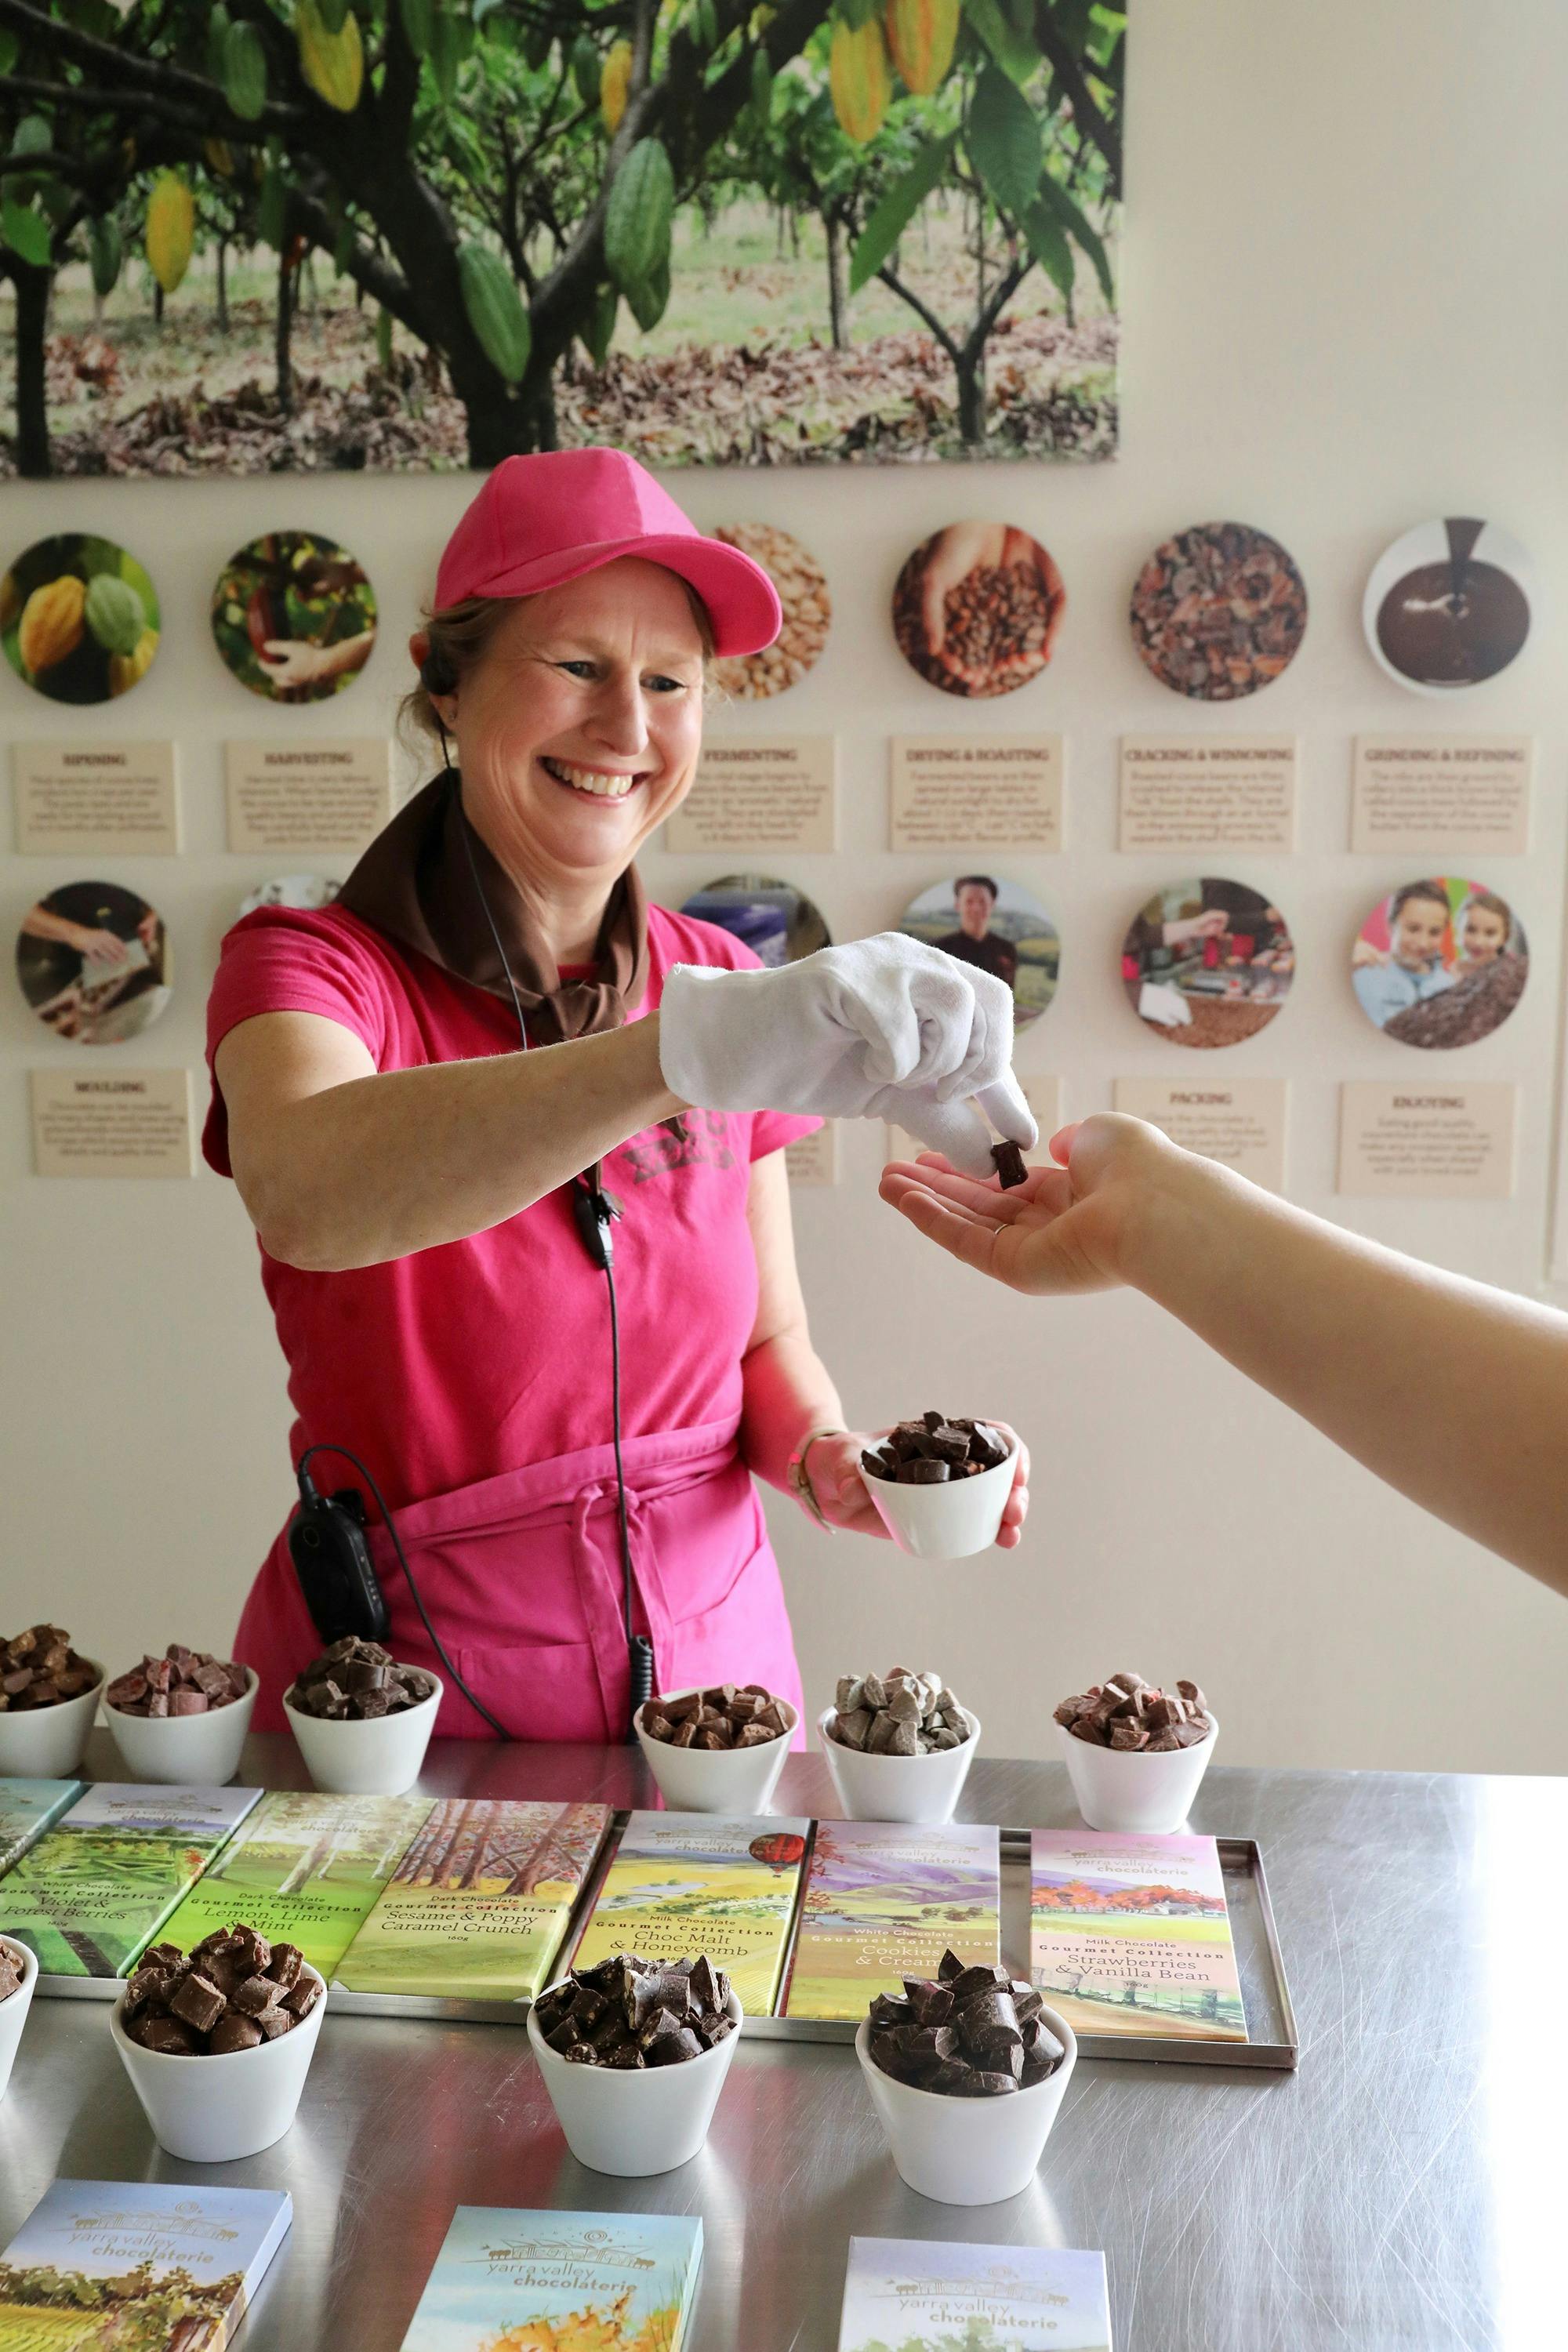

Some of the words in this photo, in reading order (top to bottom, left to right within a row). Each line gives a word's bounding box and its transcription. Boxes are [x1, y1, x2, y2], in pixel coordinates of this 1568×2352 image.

[704, 750, 797, 761] FERMENTING
[906, 749, 960, 760] DRYING
[964, 750, 973, 760] &
[976, 749, 1049, 760] ROASTING
[1125, 750, 1192, 760] CRACKING
[1197, 750, 1206, 760] &
[1441, 750, 1450, 761] &
[1170, 1092, 1232, 1105] PACKING
[1392, 1096, 1464, 1108] ENJOYING
[675, 1845, 764, 1855] chocolaterie
[1114, 1859, 1153, 1867] valley
[1098, 1865, 1188, 1875] chocolaterie
[76, 1882, 132, 1890] Chocolate
[76, 1890, 165, 1900] Collection
[268, 1894, 326, 1903] Chocolate
[39, 1896, 93, 1907] Violet
[93, 1899, 111, 1908] &
[191, 1898, 263, 1907] Gourmet
[270, 1902, 362, 1912] Collection
[2, 1906, 57, 1916] Forest
[63, 1907, 128, 1920] Berries
[203, 1907, 274, 1920] Lemon,
[279, 1911, 331, 1922] Lime
[465, 1904, 557, 1913] Collection
[387, 1911, 456, 1921] Sesame
[459, 1912, 475, 1921] &
[480, 1913, 539, 1926] Poppy
[677, 1917, 736, 1926] Chocolate
[226, 1919, 239, 1928] &
[249, 1920, 295, 1931] Mint
[381, 1921, 459, 1931] Caramel
[463, 1922, 532, 1935] Crunch
[679, 1926, 775, 1936] Collection
[633, 1930, 683, 1941] Choc
[688, 1934, 731, 1945] Malt
[892, 1929, 954, 1938] Chocolate
[811, 1935, 887, 1944] Gourmet
[896, 1938, 993, 1947] Collection
[1115, 1940, 1176, 1948] Chocolate
[610, 1940, 626, 1949] &
[631, 1941, 749, 1956] Honeycomb
[862, 1945, 941, 1957] Cookies
[1039, 1944, 1116, 1954] Gourmet
[1126, 1949, 1224, 1959] Collection
[855, 1955, 871, 1965] &
[878, 1956, 942, 1967] Cream
[1067, 1955, 1196, 1969] Strawberries
[1055, 1964, 1071, 1974] &
[1079, 1965, 1151, 1978] Vanilla
[1160, 1969, 1210, 1981] Bean
[67, 2231, 119, 2245] yarra
[122, 2232, 176, 2249] valley
[92, 2245, 215, 2264] chocolaterie
[486, 2261, 536, 2276] yarra
[541, 2263, 596, 2279] valley
[514, 2274, 638, 2293] chocolaterie
[899, 2298, 949, 2311] yarra
[953, 2298, 1011, 2314] valley
